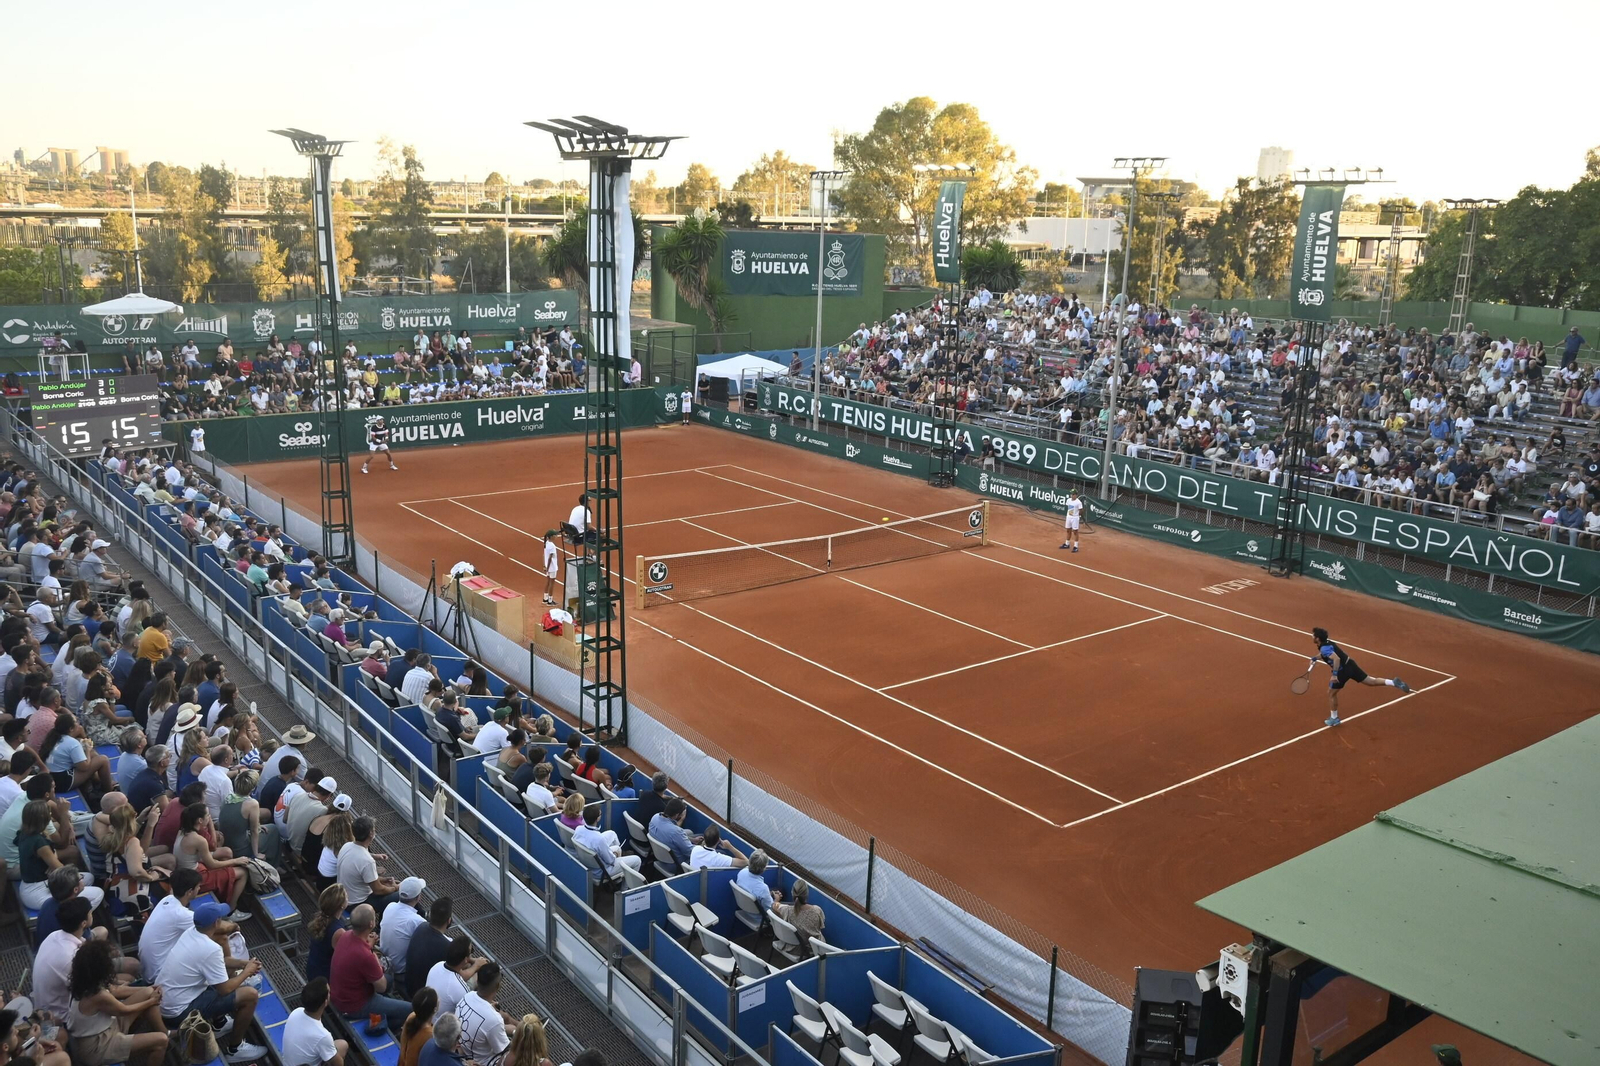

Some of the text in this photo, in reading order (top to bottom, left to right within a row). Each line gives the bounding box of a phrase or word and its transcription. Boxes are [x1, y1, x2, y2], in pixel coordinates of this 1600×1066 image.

[937, 202, 953, 267] Huelva
[1301, 212, 1316, 282] Ayuntamiento de
[1312, 210, 1334, 282] HUELVA
[751, 252, 798, 260] Ayuntamiento
[751, 261, 809, 274] HUELVA
[399, 307, 441, 315] Ayuntamiento
[467, 304, 516, 319] Huelva
[534, 308, 567, 321] Seabery
[399, 315, 452, 328] HUELVA
[98, 379, 104, 387] 3
[390, 410, 462, 425] Ayuntamiento de
[477, 405, 544, 426] Huelva
[61, 422, 91, 445] 15
[112, 417, 139, 439] 15
[391, 422, 465, 443] HUELVA
[521, 422, 544, 431] original
[990, 476, 1017, 488] Ayuntamiento
[831, 403, 886, 431] TENIS
[1177, 475, 1239, 511] DEL
[1371, 516, 1581, 587] ESPAÑOL
[989, 483, 1024, 501] HUELVA
[1030, 485, 1066, 505] Huelva
[1503, 607, 1542, 625] Barceló
